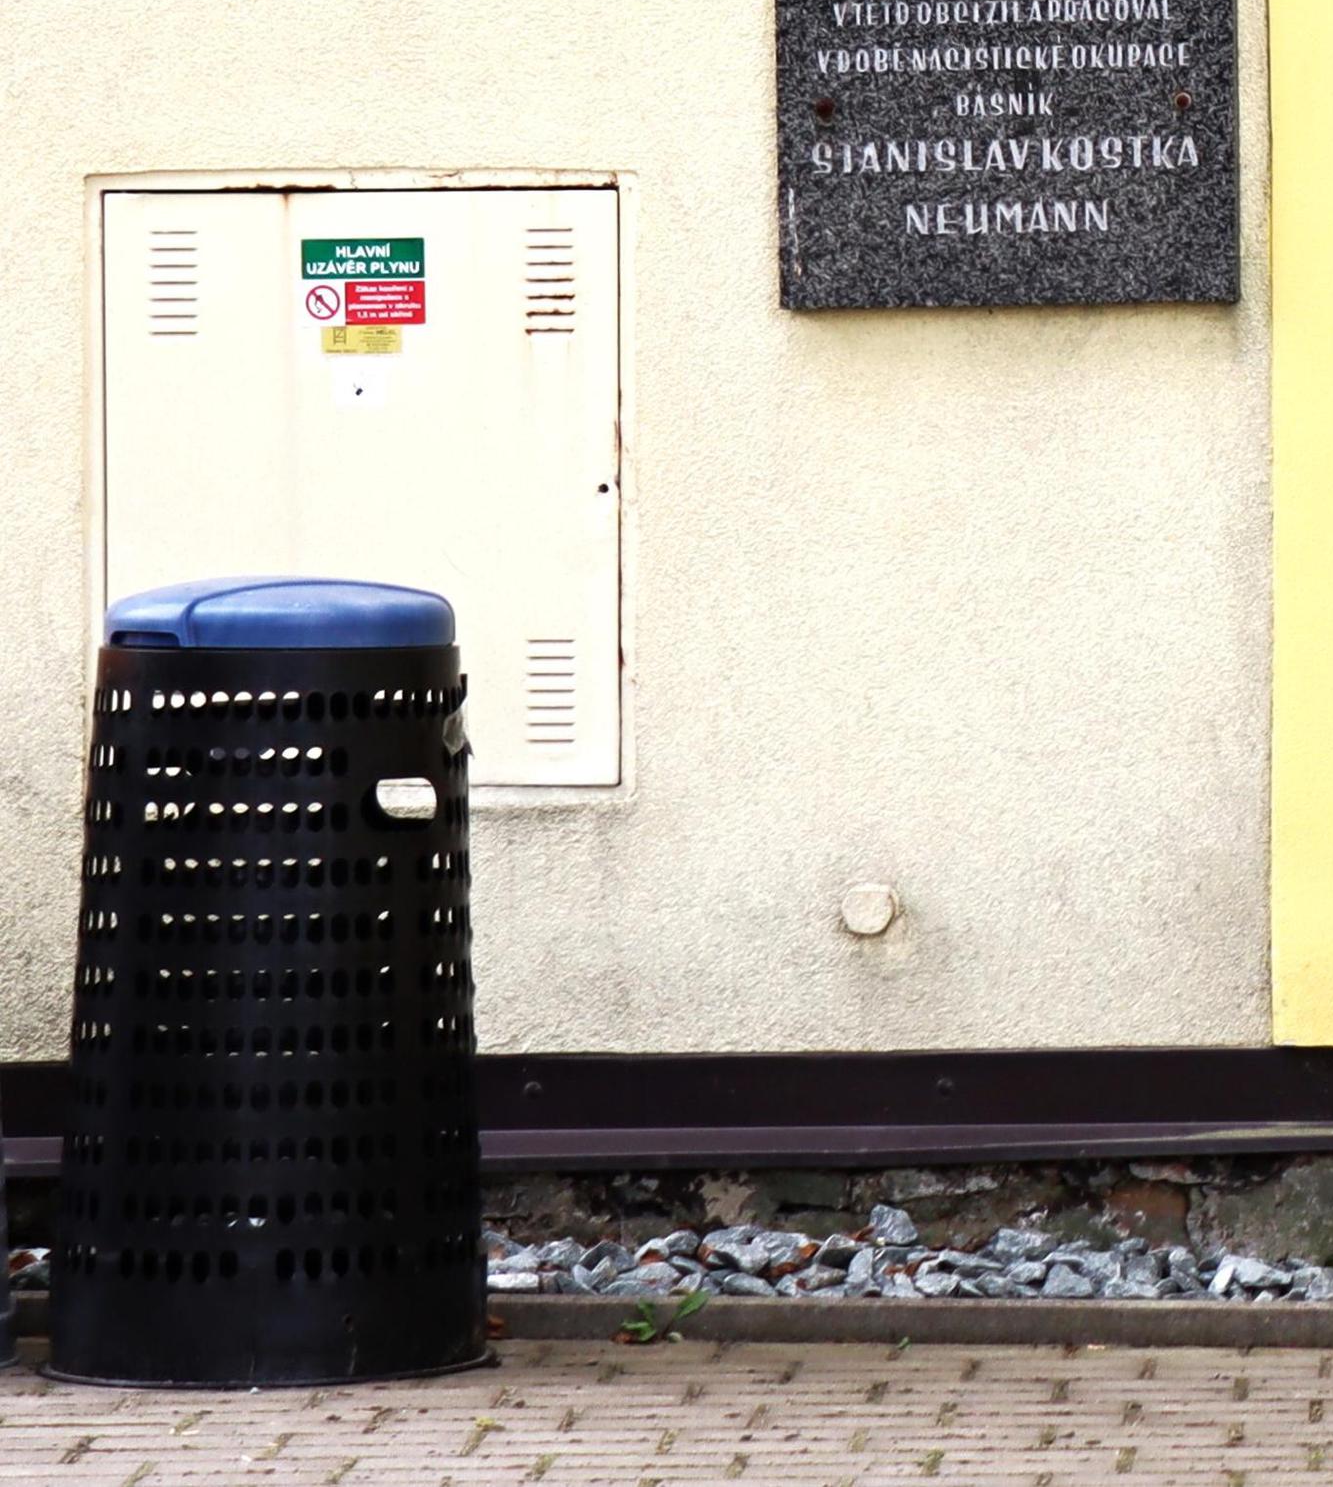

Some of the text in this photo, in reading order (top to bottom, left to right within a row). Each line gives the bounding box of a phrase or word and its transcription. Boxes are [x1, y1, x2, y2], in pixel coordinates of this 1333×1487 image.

[833, 2, 848, 27] V
[917, 0, 980, 25] OBCI
[1027, 0, 1042, 25] A
[817, 49, 830, 74] V
[1072, 42, 1190, 70] OKUPACE
[811, 135, 1199, 175] STANISLAV KOSTKA
[905, 198, 1109, 235] NEUMANN
[335, 242, 391, 259] HLAVNÍ
[306, 259, 420, 275] UZÁVĚR PLYNU
